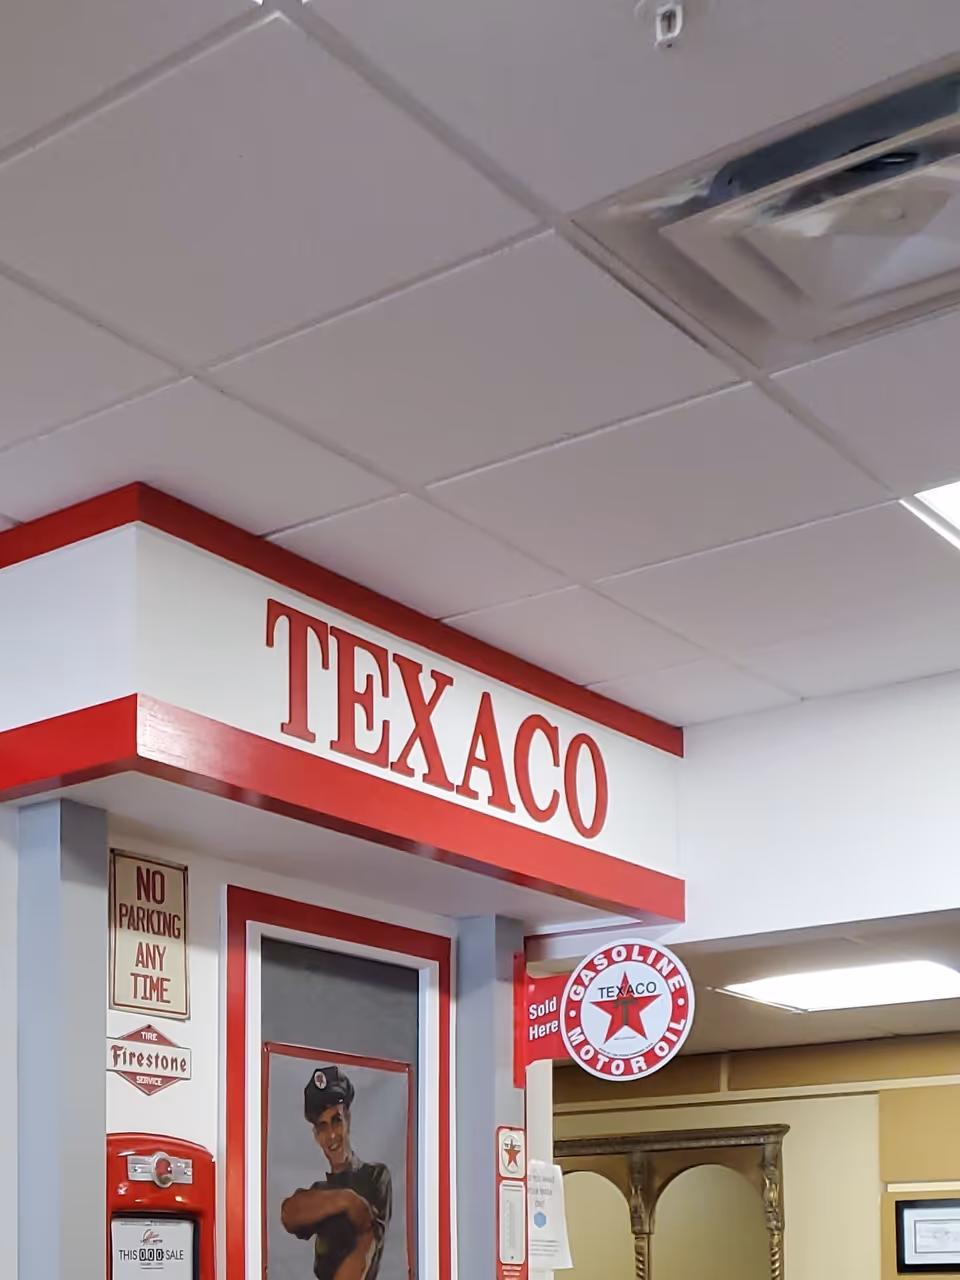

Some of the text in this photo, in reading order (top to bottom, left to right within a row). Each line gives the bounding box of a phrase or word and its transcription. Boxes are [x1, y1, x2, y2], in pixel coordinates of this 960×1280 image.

[266, 598, 609, 839] TEXACO
[136, 866, 166, 905] NO
[119, 902, 182, 939] PARKING
[135, 941, 167, 972] ANY
[130, 972, 171, 1004] TIME
[569, 945, 685, 1002] GASOLINE
[598, 981, 657, 999] TEXACO
[529, 996, 557, 1020] Sold
[140, 1031, 158, 1041] TIRE
[529, 1020, 559, 1041] Here
[110, 1044, 187, 1074] Firestone
[567, 1018, 686, 1074] MOTOR OIL
[135, 1075, 163, 1087] SERVICE
[118, 1249, 138, 1261] THIS
[165, 1249, 184, 1260] SALE
